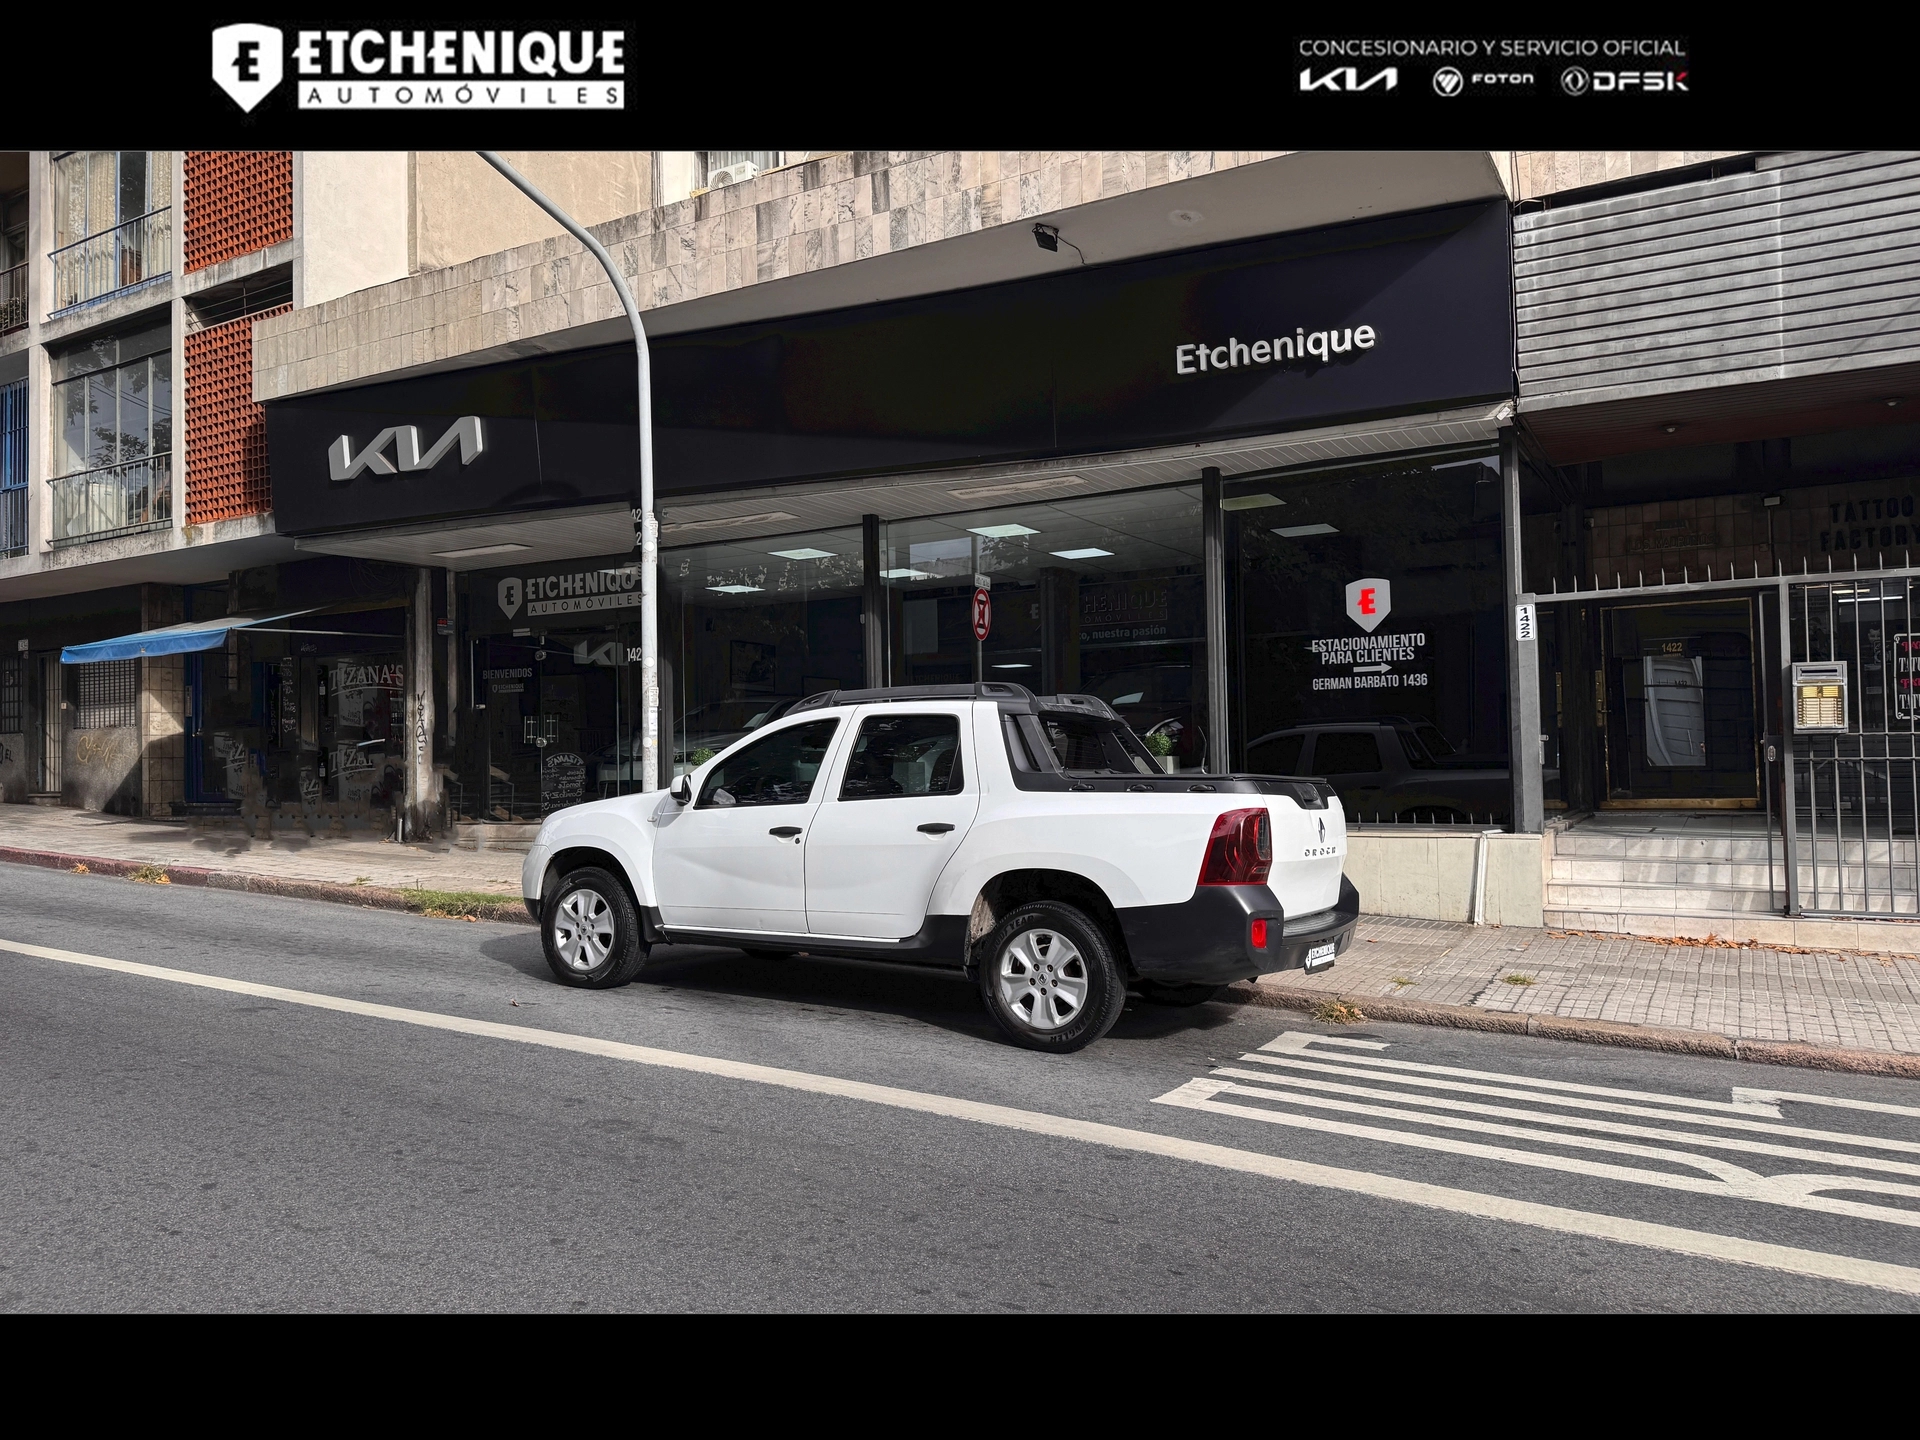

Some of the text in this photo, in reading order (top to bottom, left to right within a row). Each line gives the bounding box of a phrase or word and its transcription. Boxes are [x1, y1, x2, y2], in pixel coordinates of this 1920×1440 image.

[1176, 324, 1376, 375] Etchenique
[328, 416, 483, 480] KIA
[1829, 494, 1914, 524] TATTOO
[1820, 523, 1920, 552] FACTORY
[1084, 590, 1167, 614] HENIQUE
[1092, 626, 1130, 640] nuestra
[1132, 624, 1167, 640] pasión
[1519, 607, 1531, 639] 1422
[1312, 633, 1425, 653] ESTACIONAMIENTO
[1661, 642, 1683, 653] 1422
[627, 647, 642, 662] 142
[1321, 647, 1415, 665] PARA CLIENTES
[329, 663, 403, 691] TIZANA'S
[483, 667, 533, 680] BIENVENIDOS
[1312, 673, 1428, 690] GERMAN BARBATO 1436
